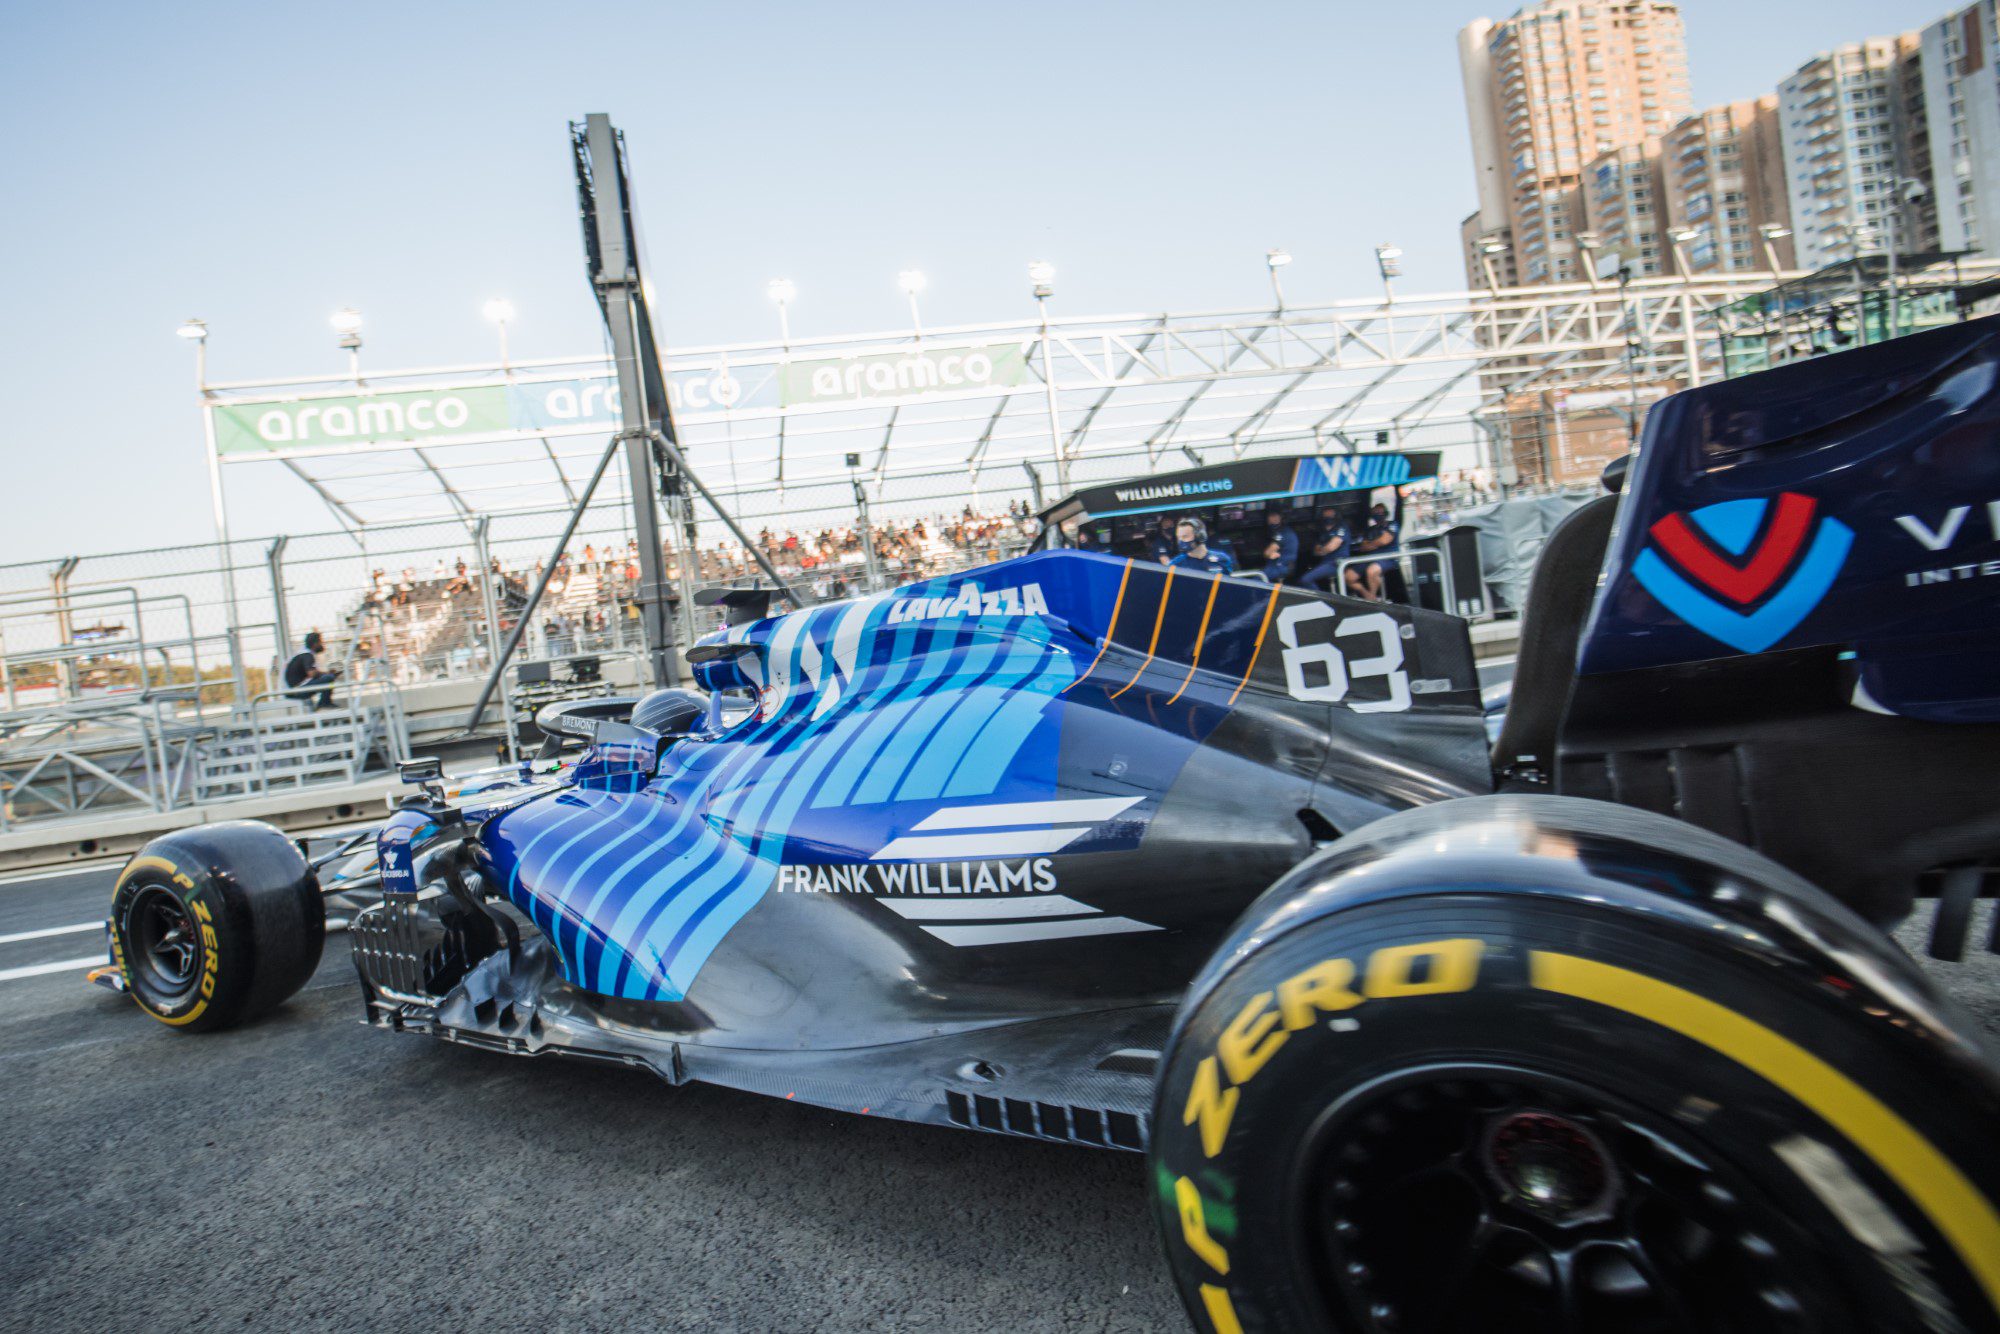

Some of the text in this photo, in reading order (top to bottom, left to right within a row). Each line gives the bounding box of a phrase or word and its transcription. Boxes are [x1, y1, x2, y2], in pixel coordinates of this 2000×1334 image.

[811, 353, 992, 397] aramco
[257, 396, 469, 442] aramco
[1115, 478, 1233, 502] WILLIAMS RACING
[887, 582, 1050, 625] LAVAZZA
[1276, 601, 1413, 713] 63
[562, 715, 597, 732] BREMONT
[777, 858, 1057, 894] FRANK WILLIAMS
[172, 872, 219, 1001] P ZERO
[1175, 938, 1486, 1276] P ZERO
